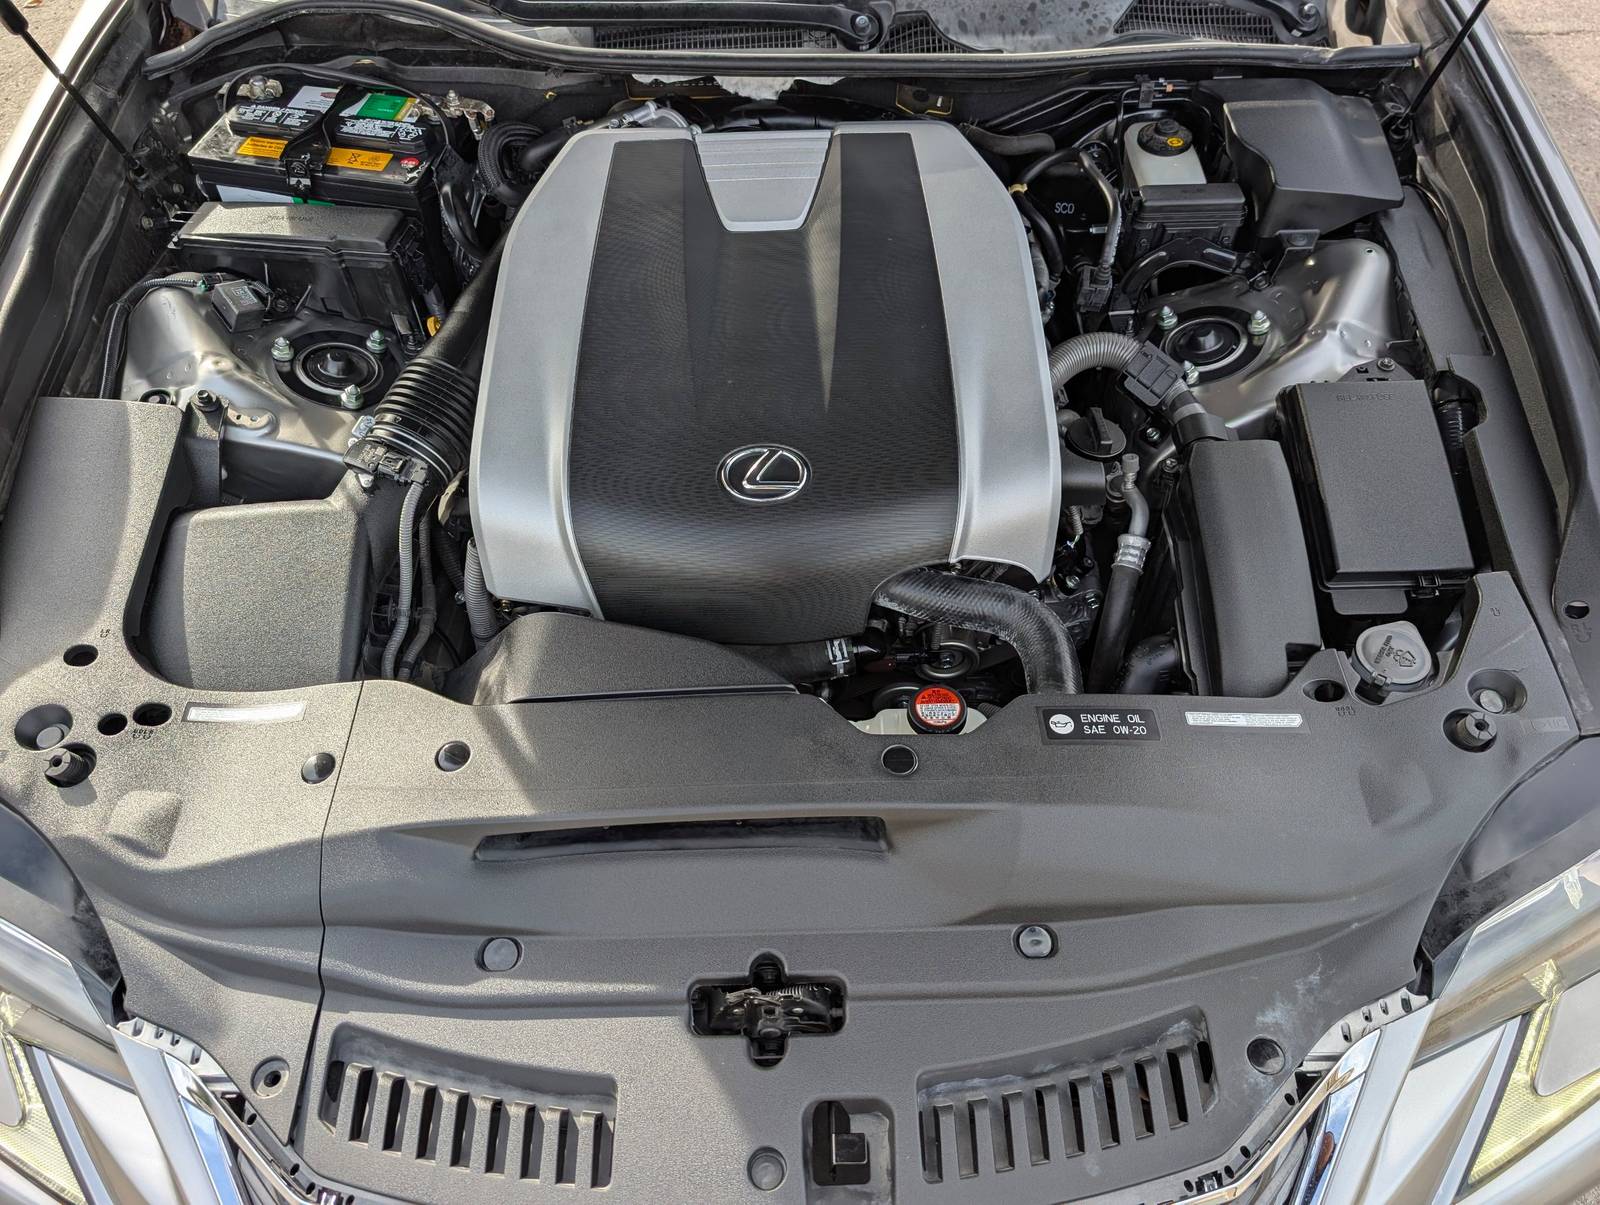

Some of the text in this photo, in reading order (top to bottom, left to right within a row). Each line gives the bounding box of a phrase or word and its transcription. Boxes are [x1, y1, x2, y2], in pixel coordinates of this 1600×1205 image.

[1080, 713, 1146, 724] ENGINE OIL
[1083, 724, 1147, 735] SAE 0W-20
